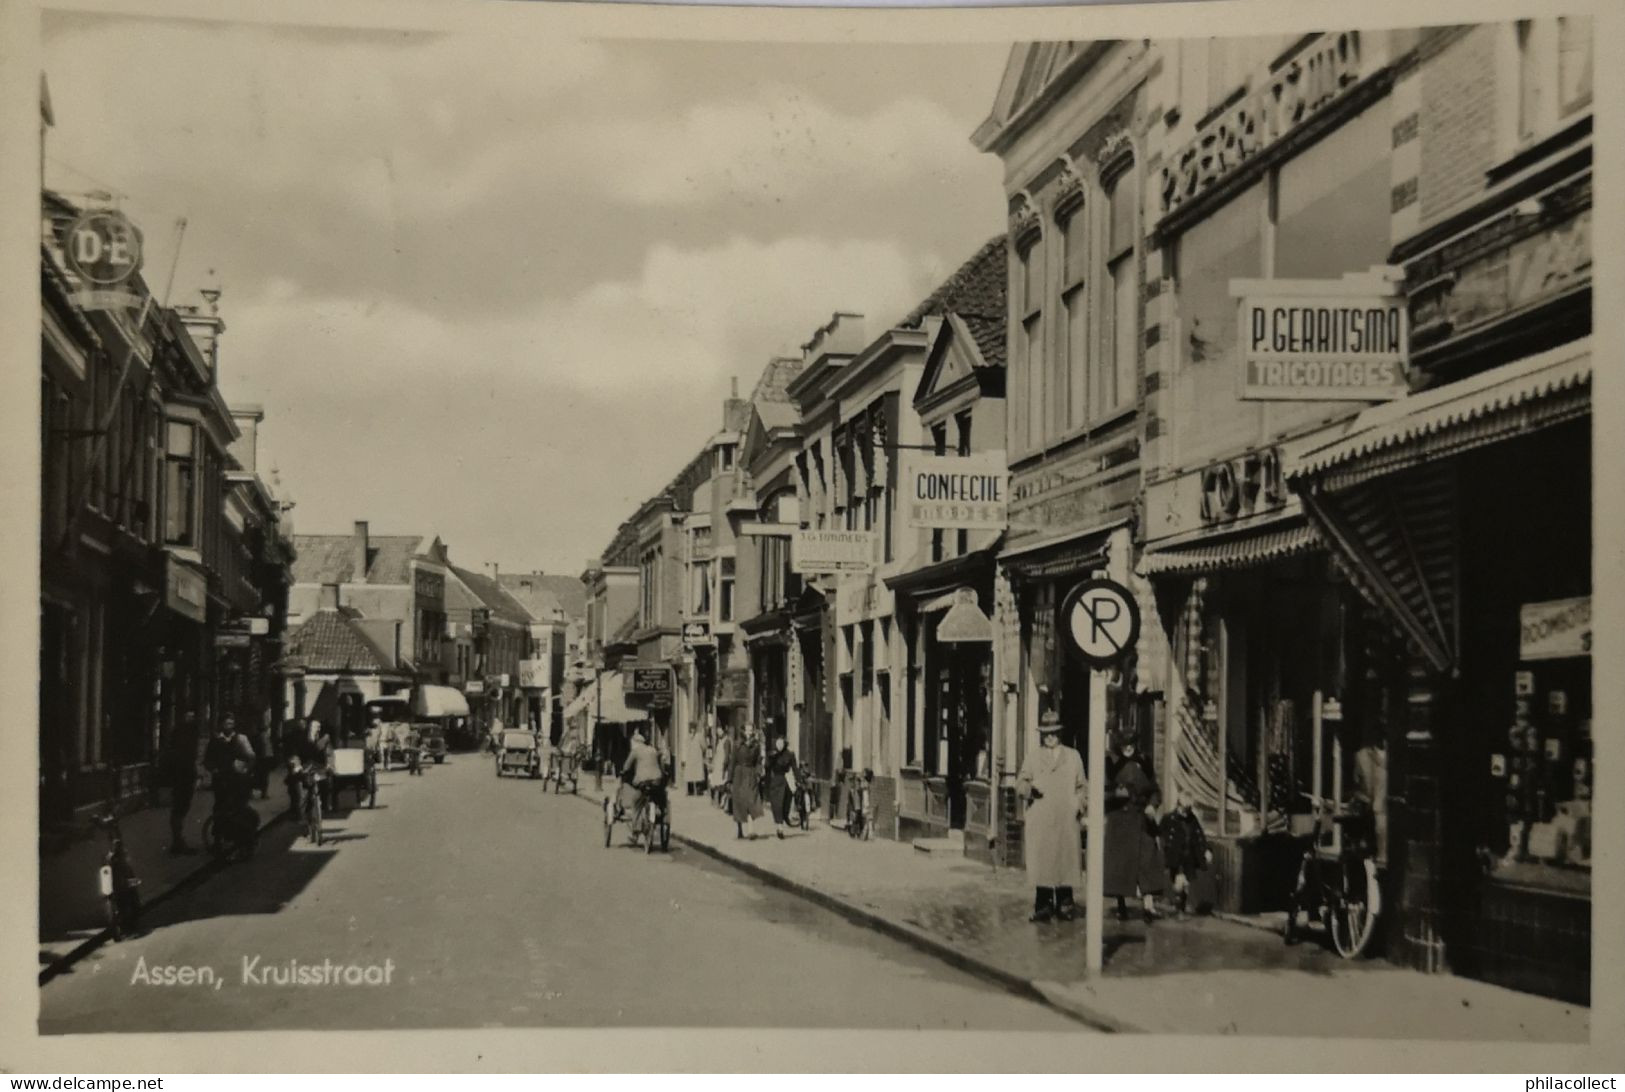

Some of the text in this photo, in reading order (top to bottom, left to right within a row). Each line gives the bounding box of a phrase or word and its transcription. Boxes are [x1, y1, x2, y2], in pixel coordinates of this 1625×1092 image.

[1254, 361, 1395, 386] TRICOTAGES
[917, 472, 1001, 502] CONFECTIE
[1092, 597, 1120, 644] P
